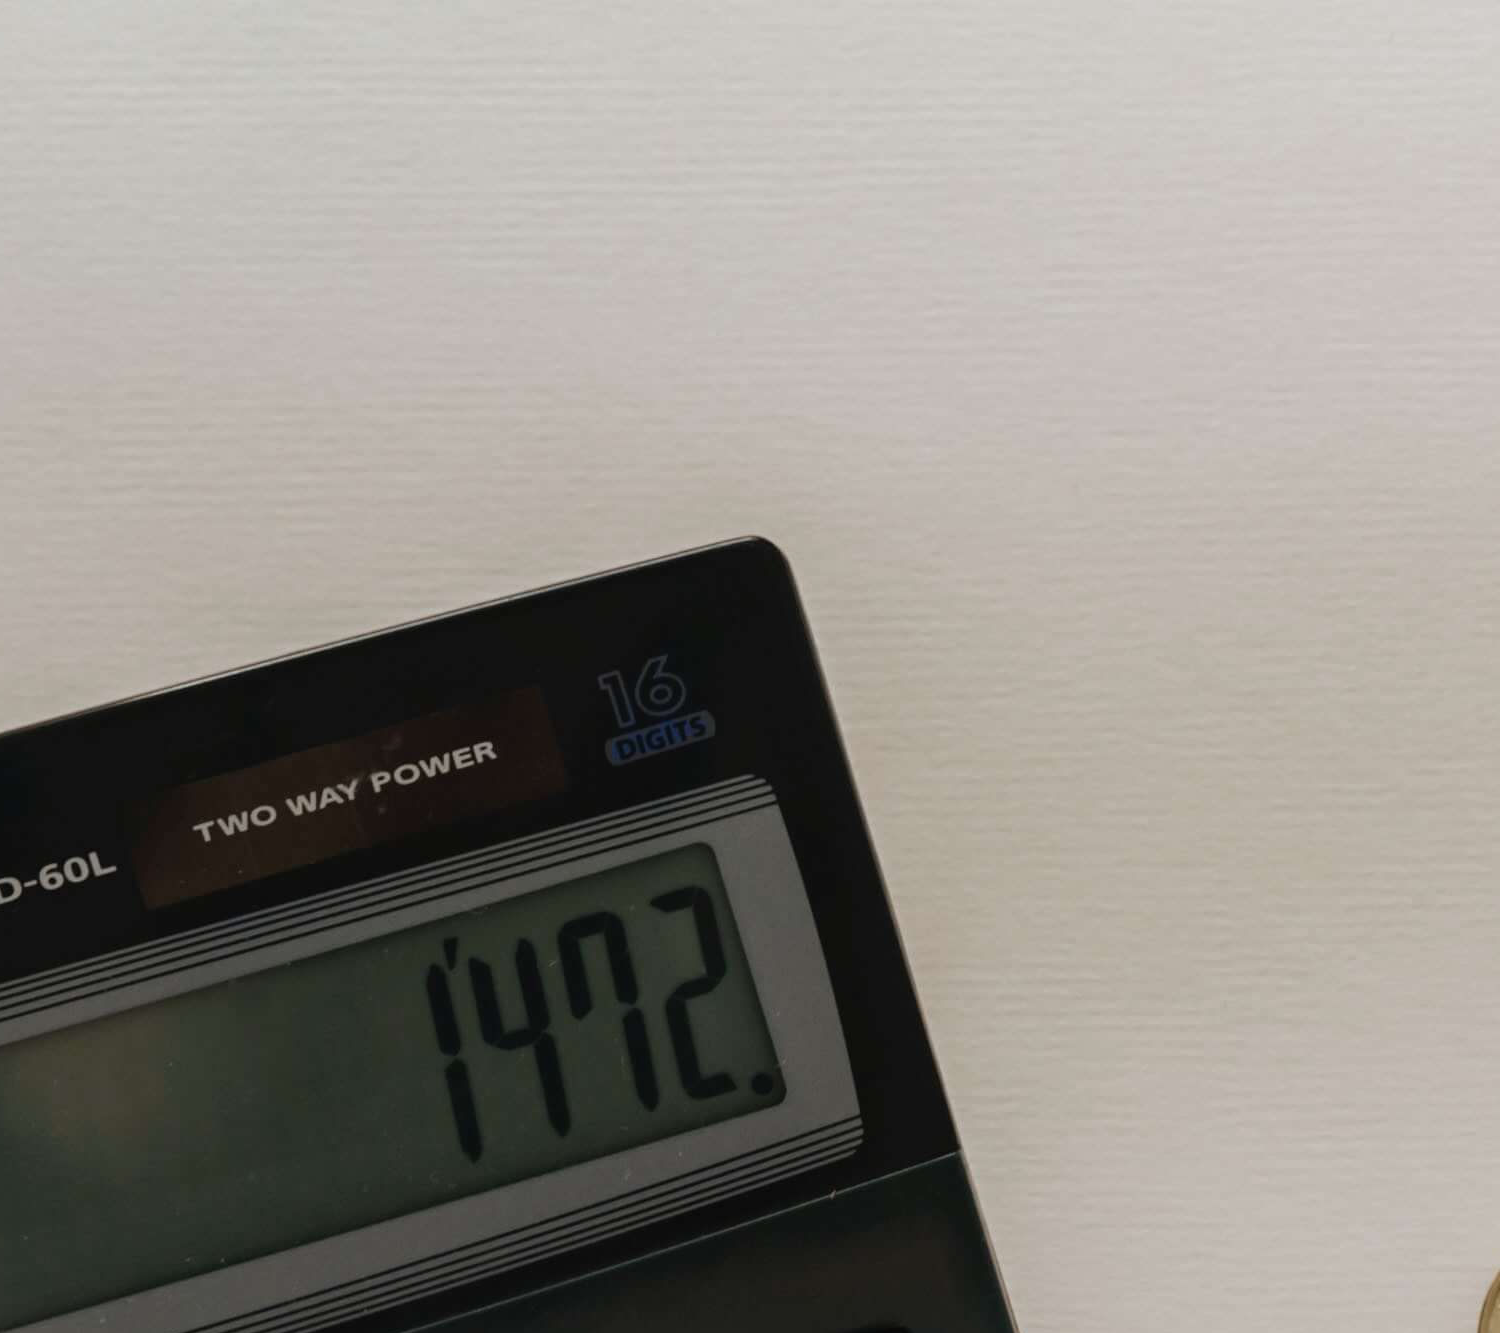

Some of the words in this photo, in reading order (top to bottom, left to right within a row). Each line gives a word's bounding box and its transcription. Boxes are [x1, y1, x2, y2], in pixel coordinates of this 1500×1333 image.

[598, 656, 686, 728] 16
[612, 716, 708, 764] DIGITS
[192, 805, 277, 843] TWO
[285, 778, 359, 817] WAY
[370, 741, 497, 793] POWER
